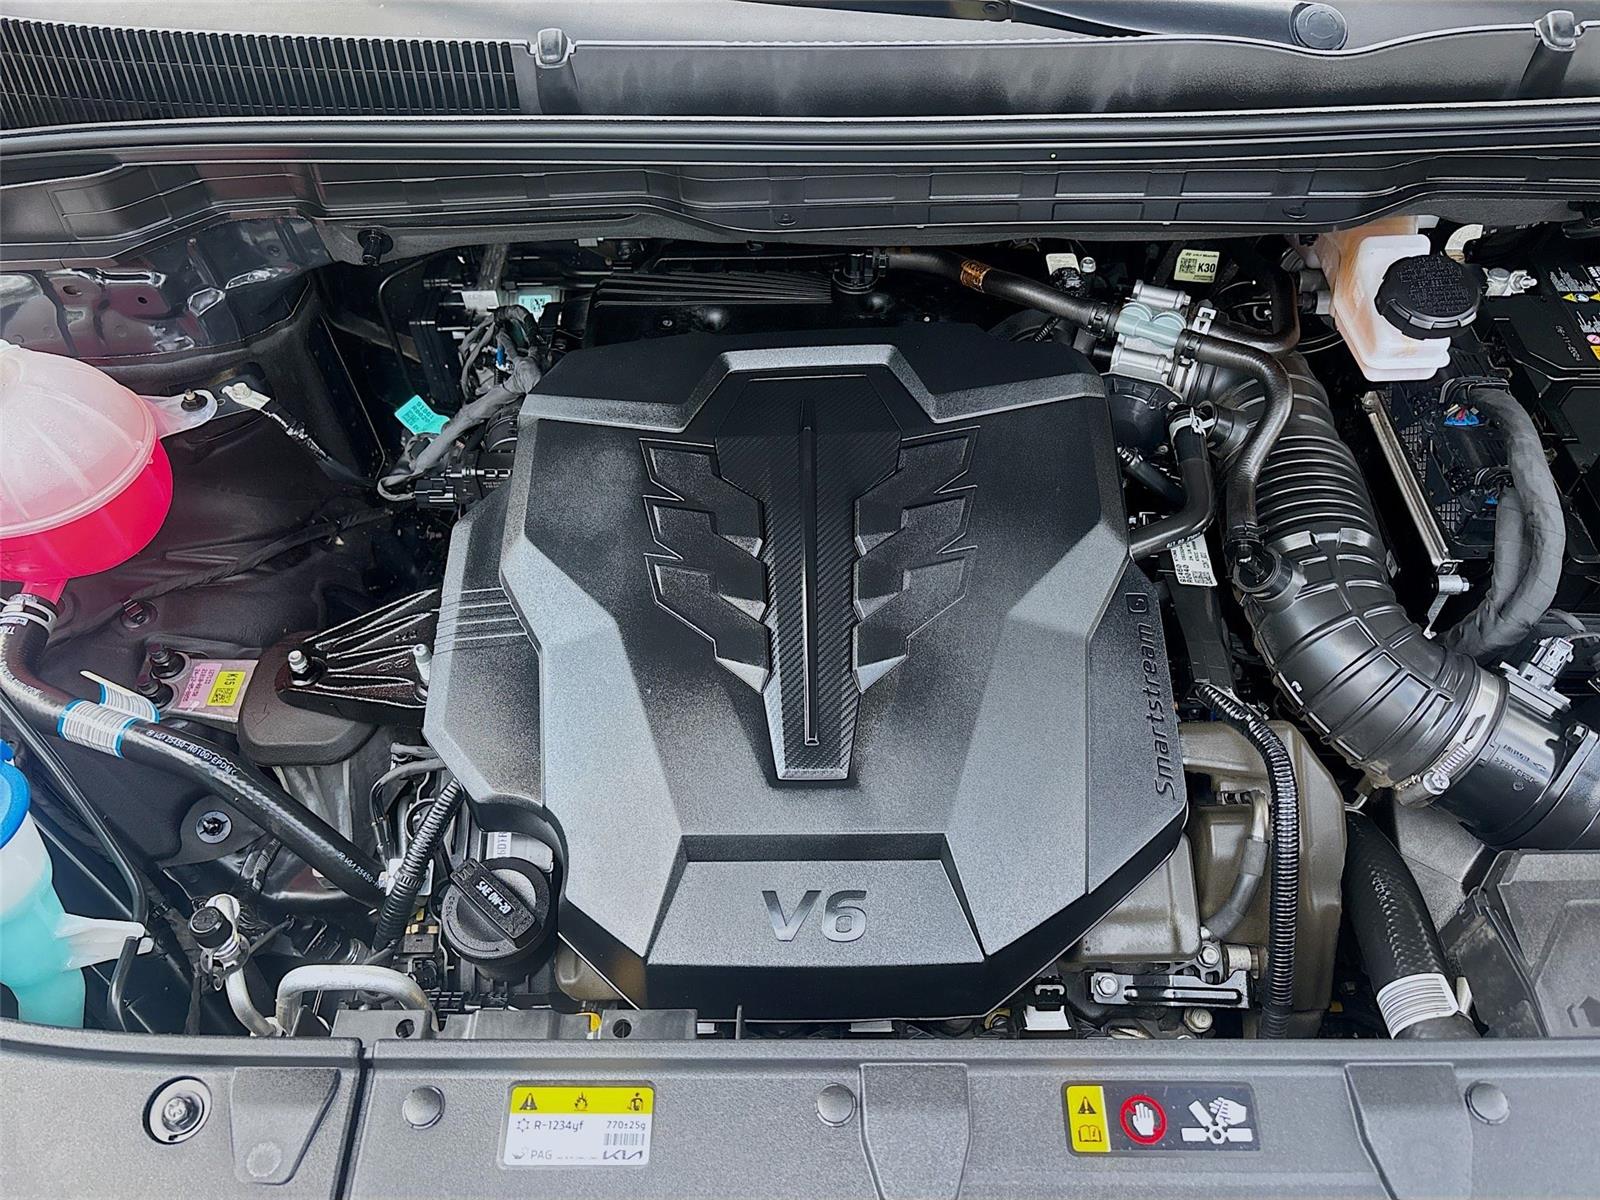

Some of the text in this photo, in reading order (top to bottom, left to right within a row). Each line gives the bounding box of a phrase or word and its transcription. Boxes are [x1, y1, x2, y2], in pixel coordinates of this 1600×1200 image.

[1197, 262, 1216, 273] K30
[224, 672, 239, 686] K15
[1138, 622, 1176, 801] Smartstream
[475, 881, 512, 915] SAE 0W-20
[762, 890, 868, 943] V6
[534, 1120, 584, 1133] R-1234yf
[530, 1149, 553, 1160] PAG
